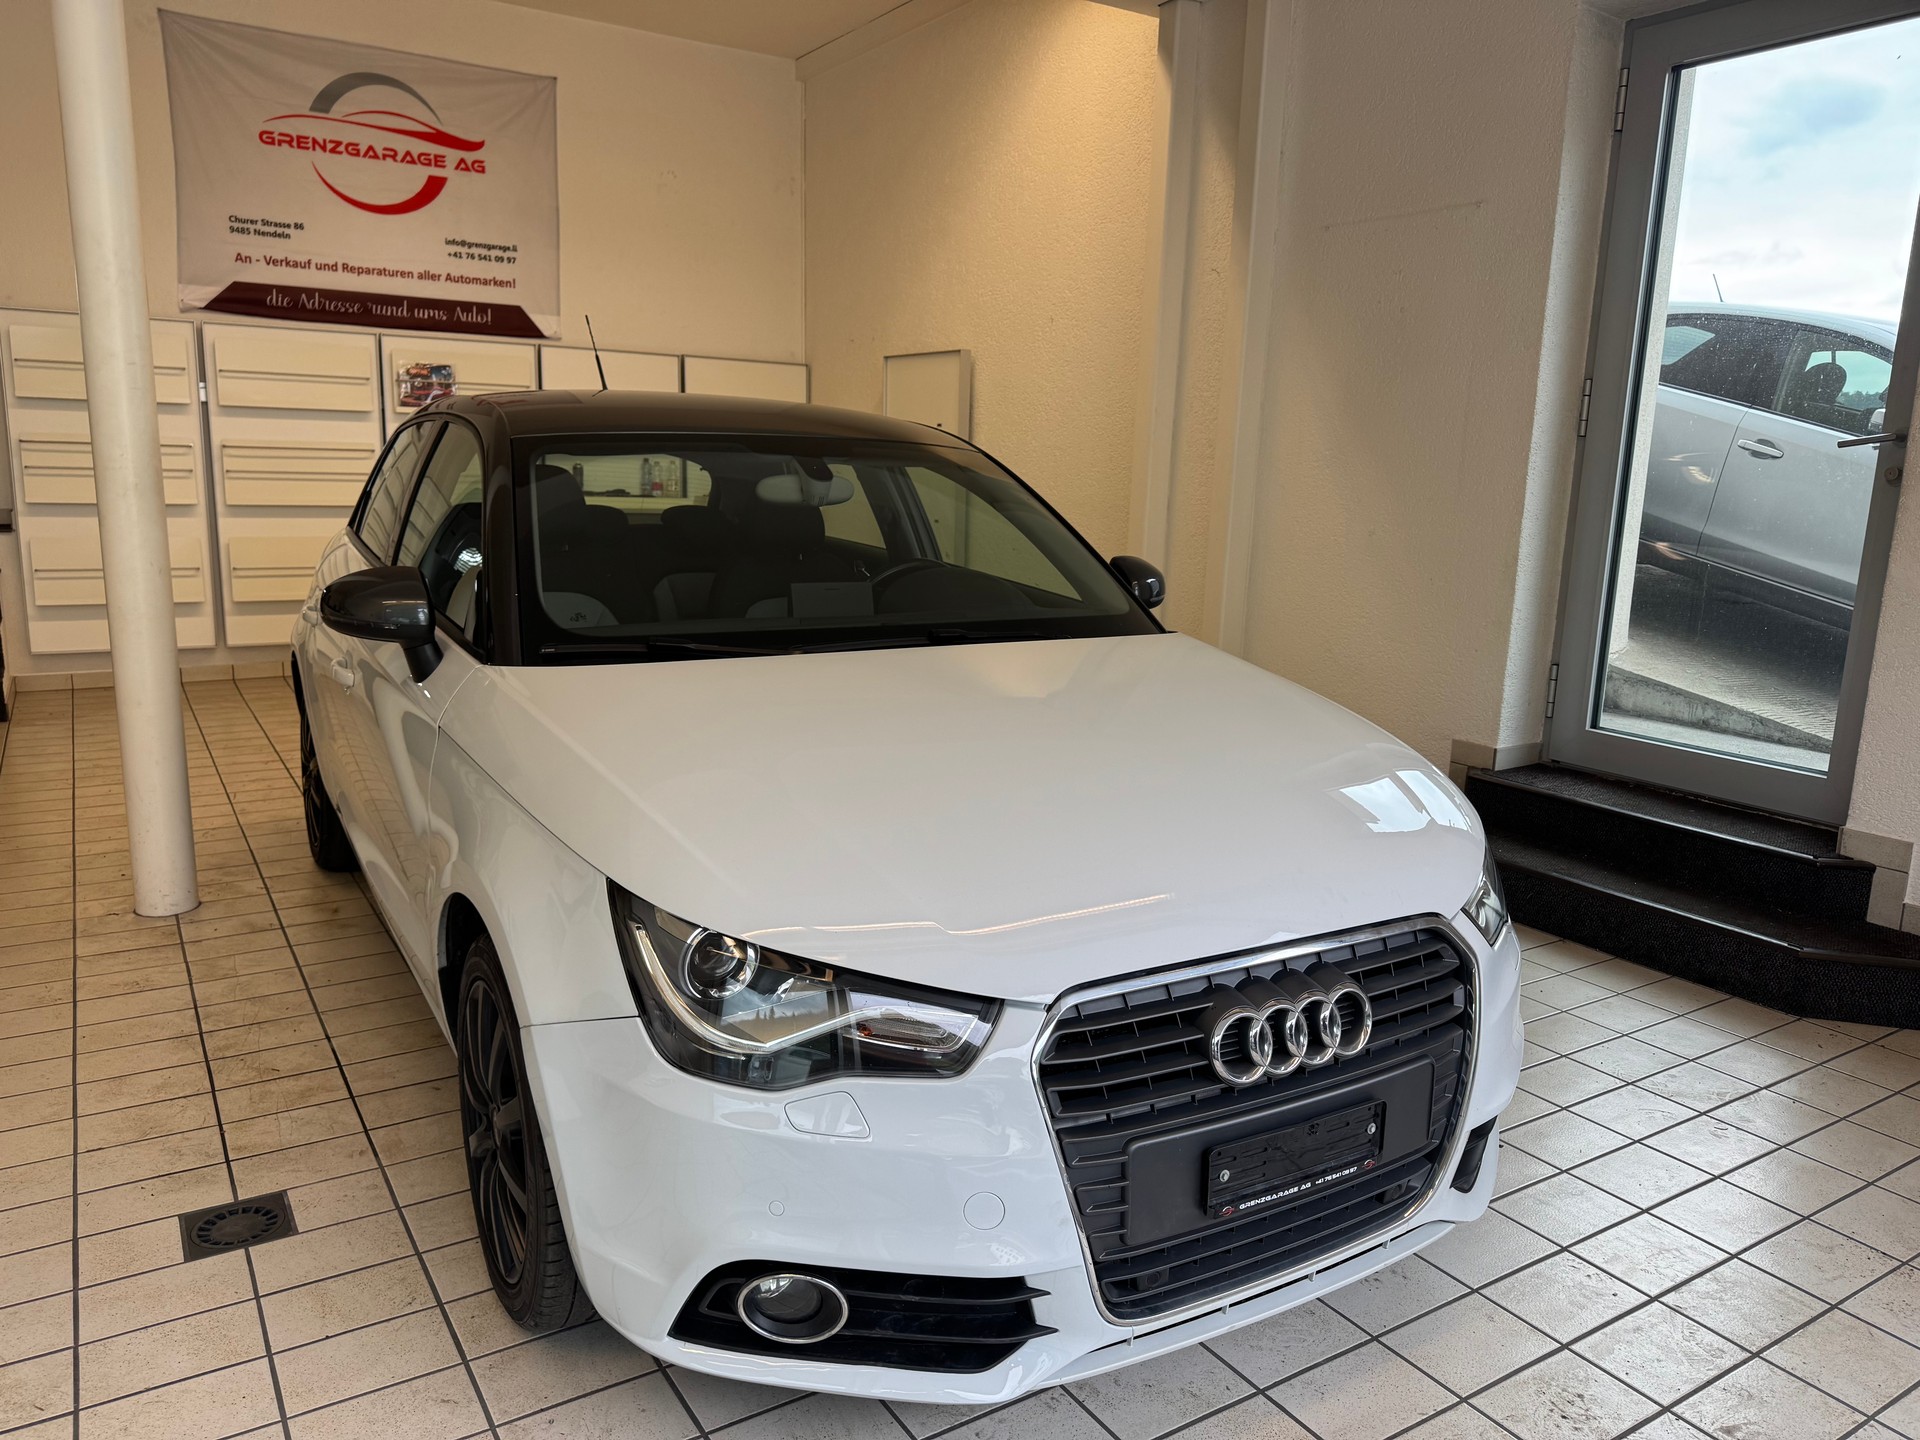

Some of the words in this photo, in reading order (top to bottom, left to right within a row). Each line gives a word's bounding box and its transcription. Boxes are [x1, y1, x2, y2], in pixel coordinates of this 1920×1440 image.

[258, 130, 447, 169] GRENZGARAGE
[454, 157, 486, 174] AG
[228, 215, 258, 225] Churer
[260, 218, 292, 229] Strasse
[293, 222, 305, 231] 86
[229, 225, 251, 235] 9485
[253, 228, 291, 240] Nendeln
[444, 237, 518, 253] info@grenzgarage.li
[447, 251, 463, 259] +41
[465, 252, 476, 260] 76
[477, 253, 492, 262] 541
[494, 255, 505, 264] 09
[506, 257, 517, 265] 97
[234, 252, 252, 265] An
[263, 255, 312, 270] Verkauf
[315, 261, 338, 272] und
[341, 263, 414, 279] Reparaturen
[416, 270, 442, 283] aller
[444, 272, 517, 290] Automarken!
[266, 288, 293, 308] die
[298, 292, 364, 315] Adresse
[367, 301, 411, 318] rund
[414, 308, 448, 321] ums
[453, 305, 492, 325] Auto!
[1239, 1186, 1299, 1209] GRENZGARAGE
[1300, 1182, 1312, 1190] AG
